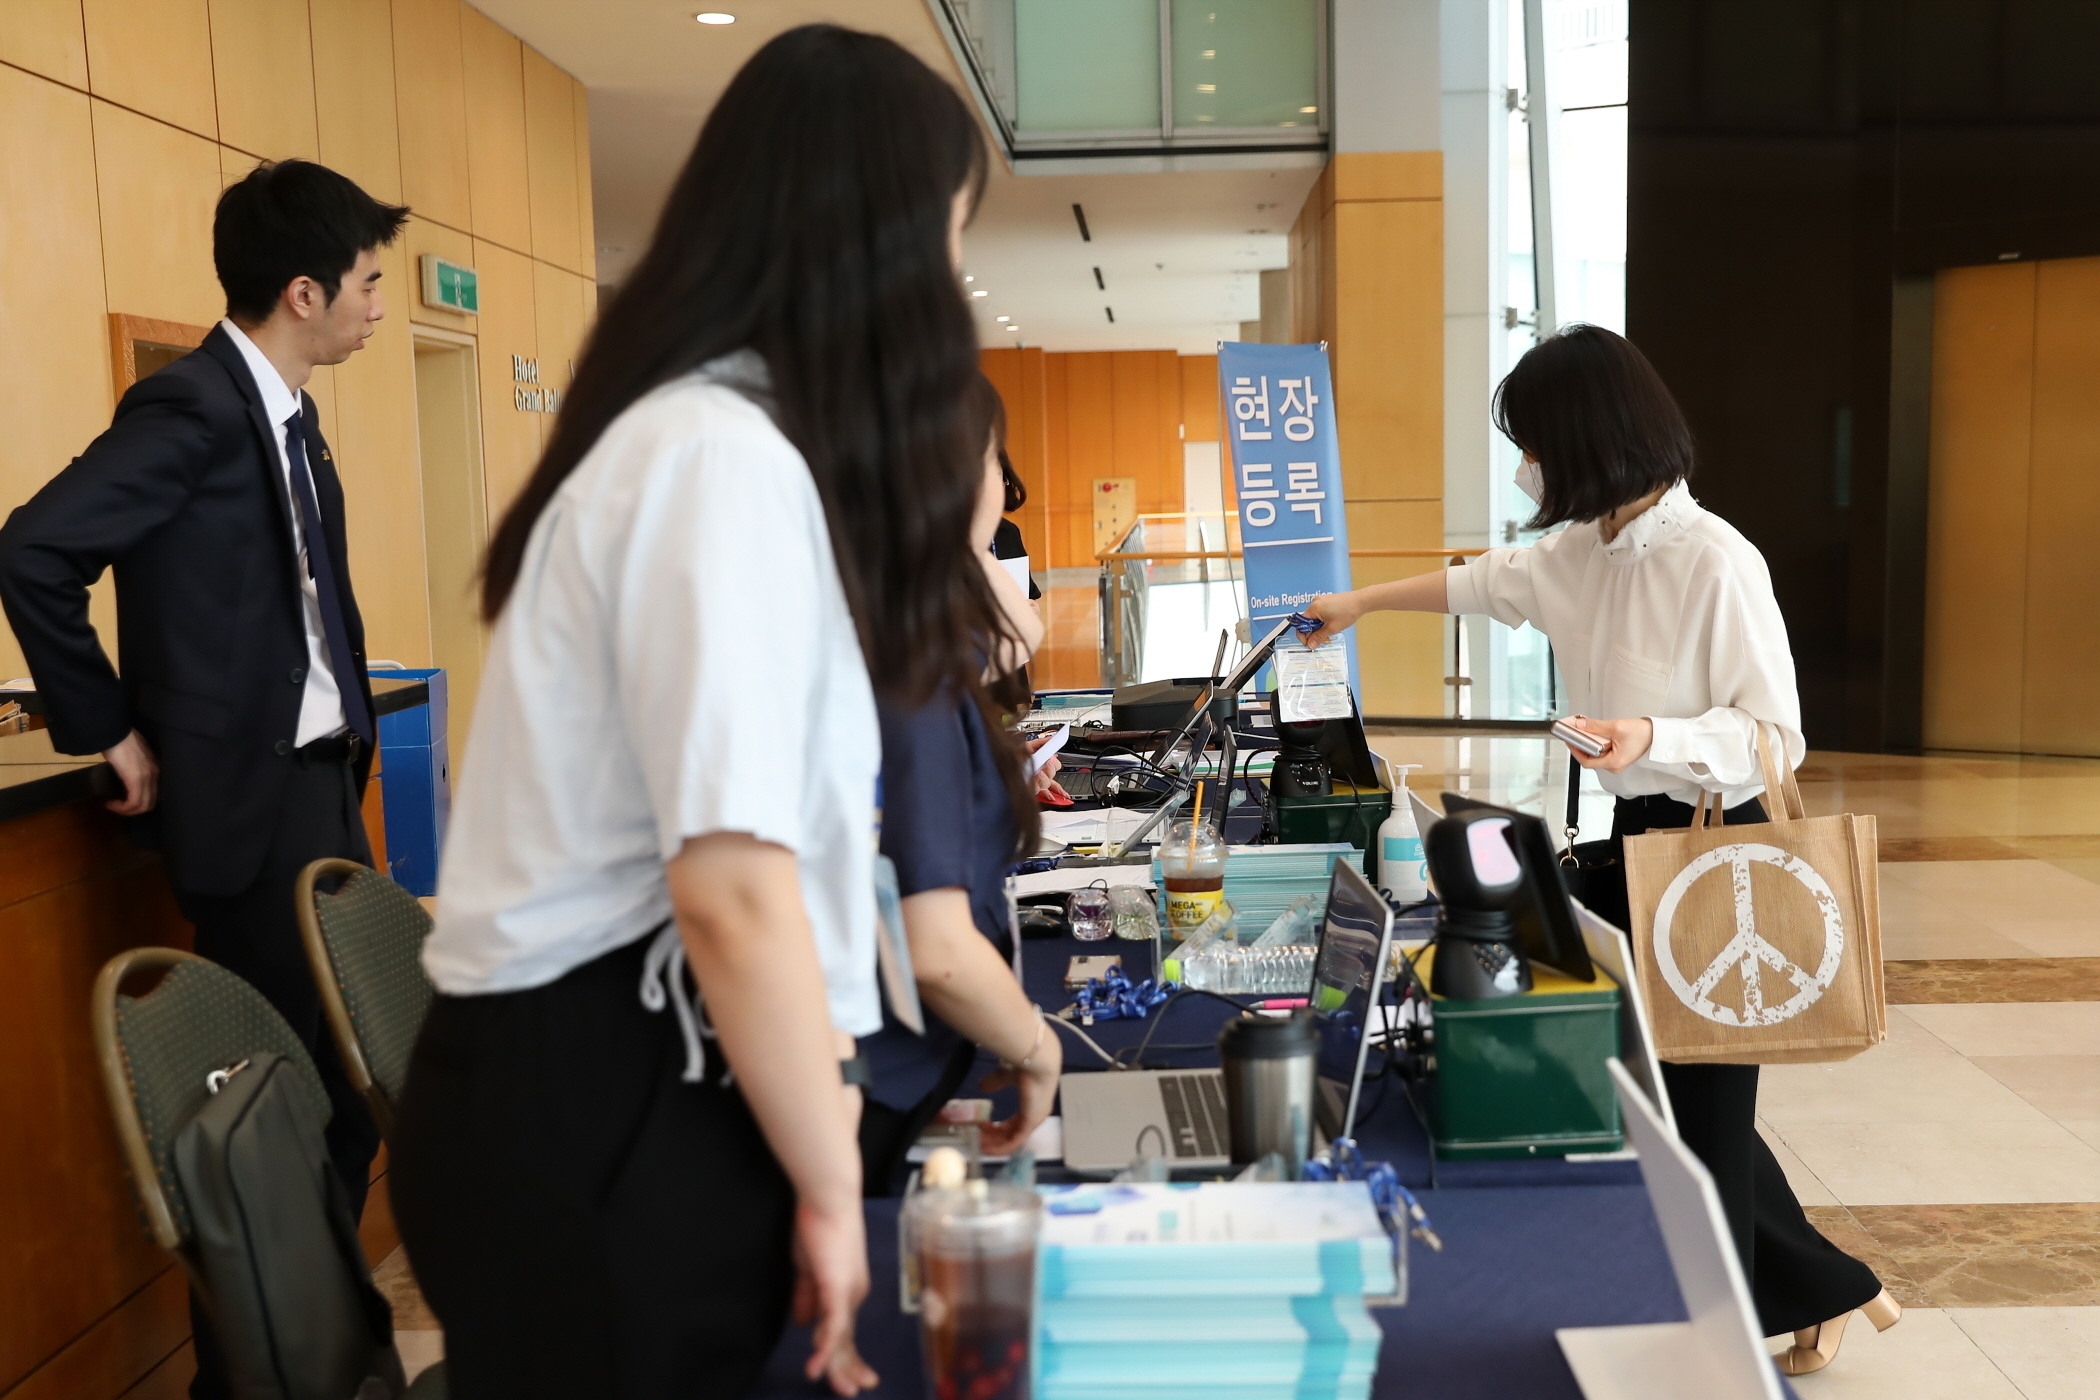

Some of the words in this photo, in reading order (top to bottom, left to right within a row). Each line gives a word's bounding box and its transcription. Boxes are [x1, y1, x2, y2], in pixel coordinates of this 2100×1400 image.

[513, 354, 539, 384] Hotel
[514, 384, 542, 412] Grand
[1231, 375, 1319, 442] 현장
[1240, 461, 1326, 527] 등록
[1251, 595, 1279, 608] On-site
[1171, 901, 1196, 909] MEGA
